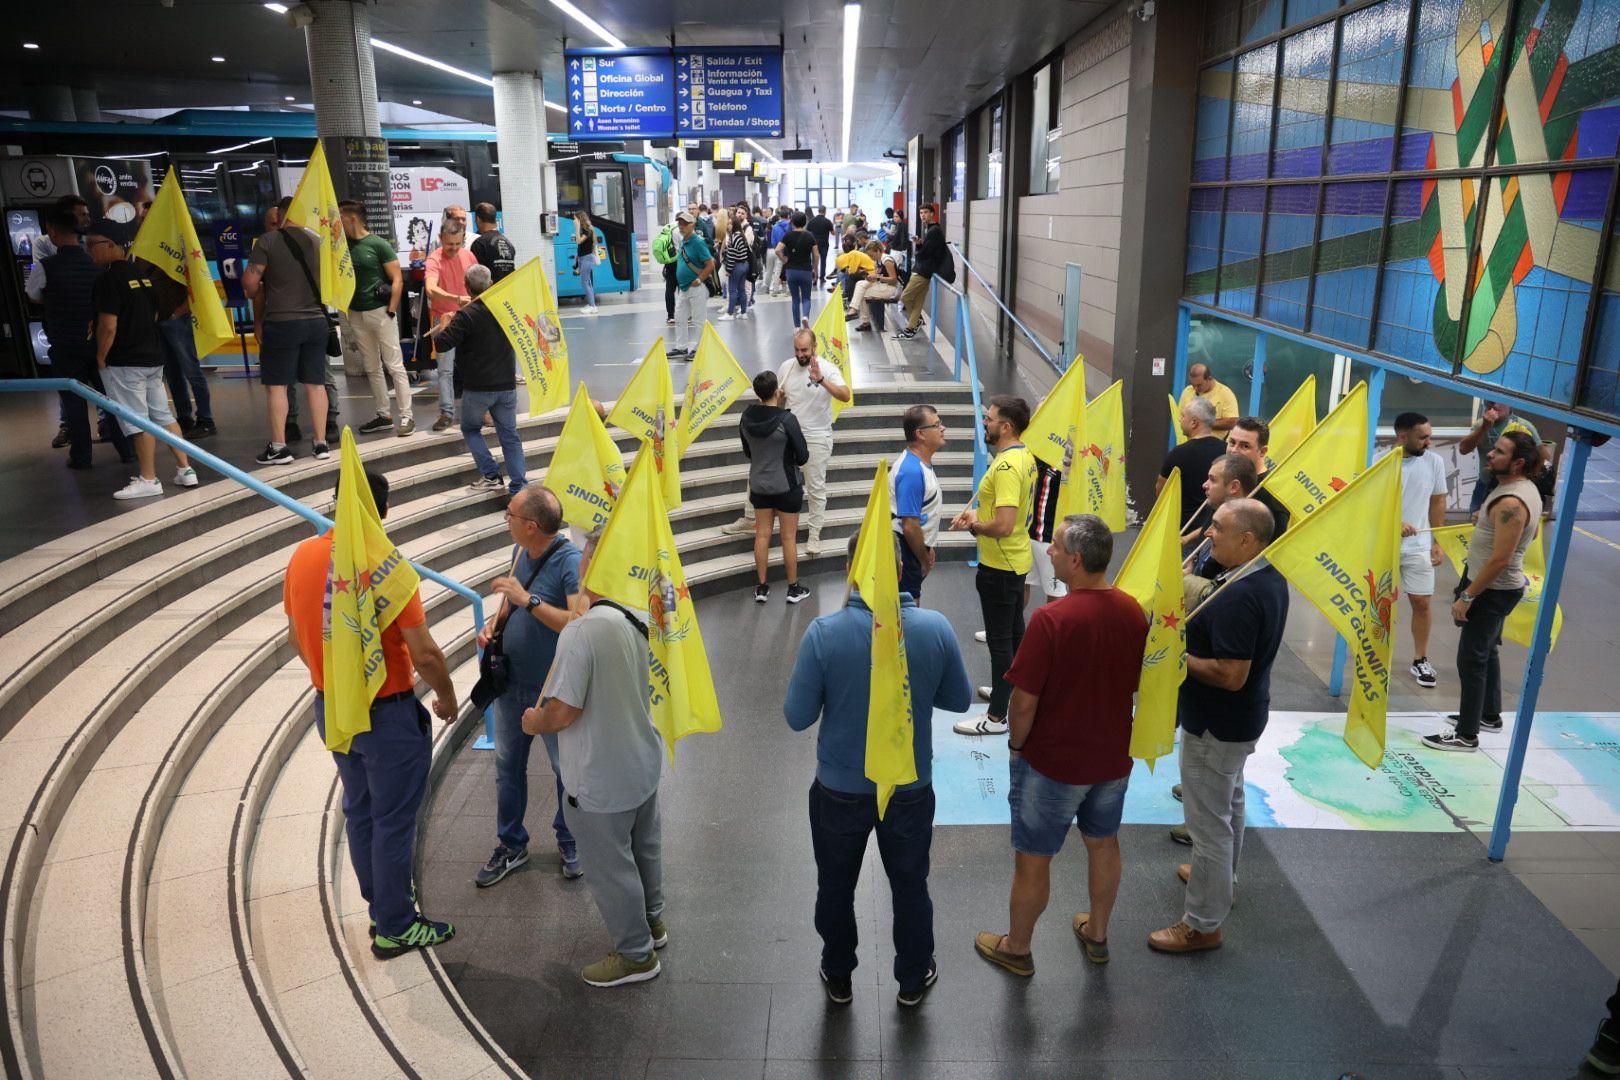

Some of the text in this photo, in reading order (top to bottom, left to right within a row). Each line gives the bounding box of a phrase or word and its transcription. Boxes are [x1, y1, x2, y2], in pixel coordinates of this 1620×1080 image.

[598, 59, 615, 67] Sur
[707, 57, 735, 65] Salida
[744, 57, 762, 65] Exit
[600, 73, 664, 82] Oficina Global
[707, 69, 762, 77] Información
[600, 89, 644, 97] Dirección
[707, 87, 772, 97] Guagua y Taxi
[600, 104, 626, 112] Norte
[635, 104, 667, 112] Centro
[707, 102, 747, 110] Teléfono
[708, 118, 744, 126] Tiendas
[751, 117, 780, 127] Shops
[502, 300, 533, 347] SINDICATO
[509, 323, 519, 337] DE
[1315, 551, 1367, 612] SINDICA
[1329, 593, 1354, 616] DE
